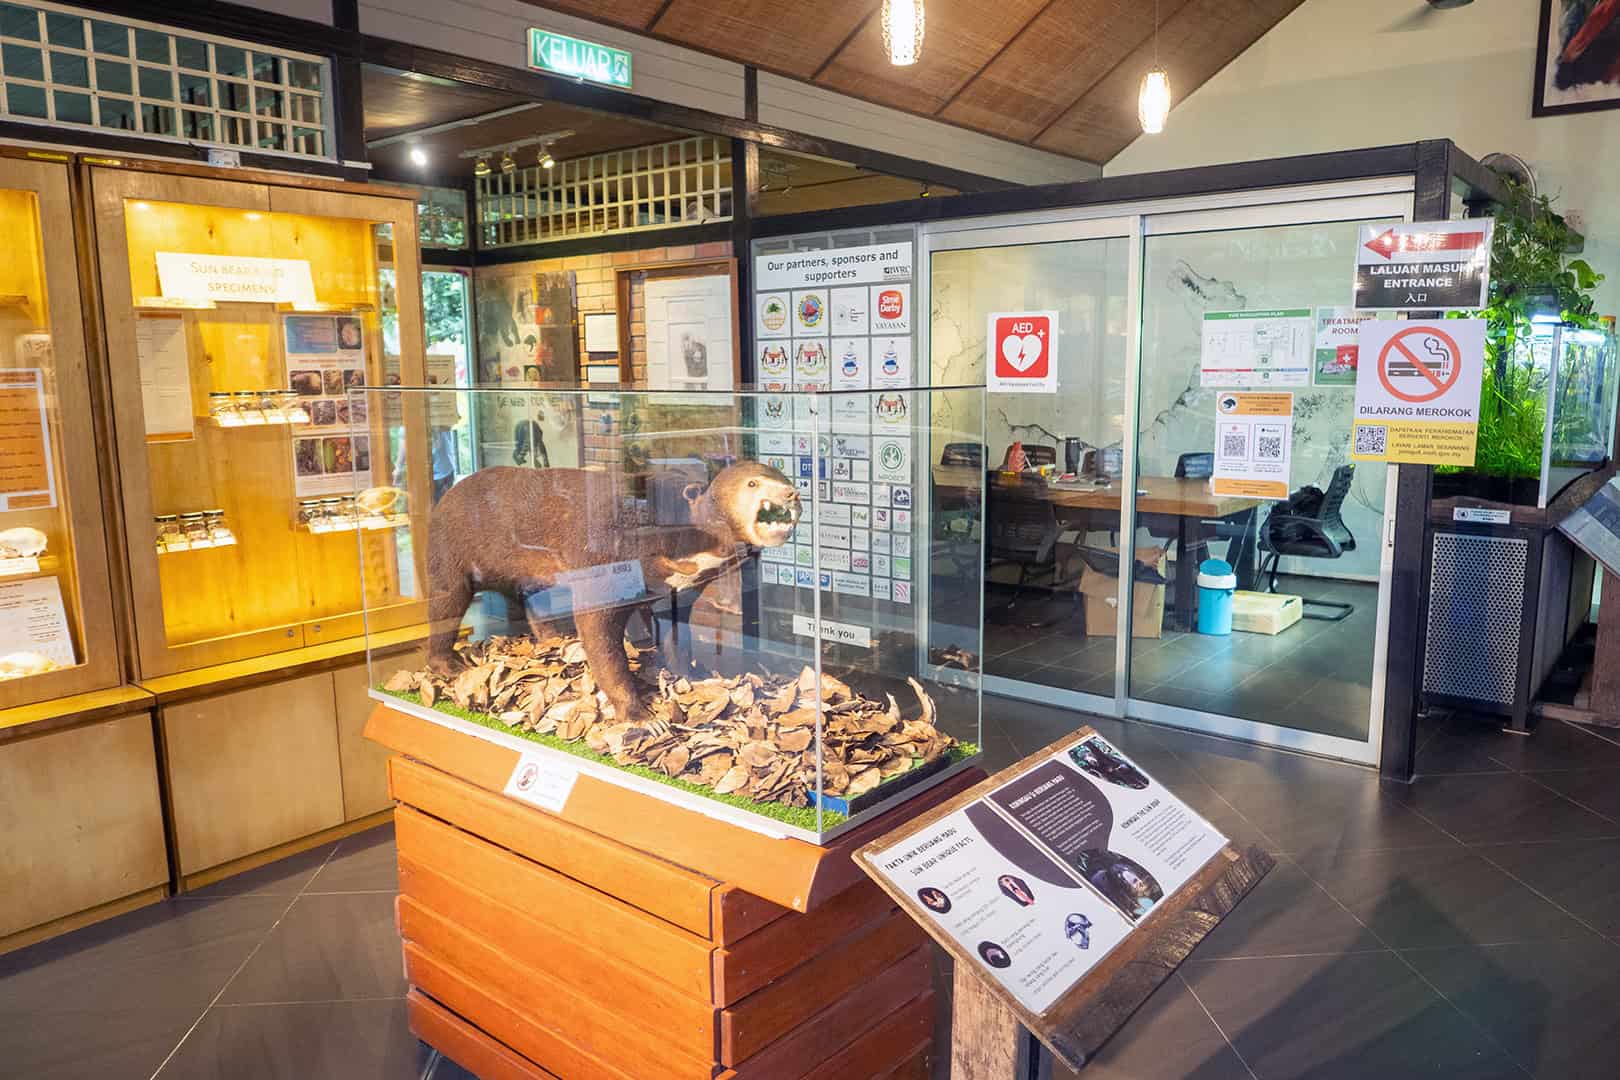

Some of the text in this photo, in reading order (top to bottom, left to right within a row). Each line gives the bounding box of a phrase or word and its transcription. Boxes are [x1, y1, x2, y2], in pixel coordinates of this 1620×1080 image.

[535, 32, 611, 77] KELUAR
[767, 249, 898, 271] Our partners, sponsors and
[1370, 264, 1419, 275] LALUAN
[804, 269, 857, 282] supporters
[1383, 278, 1453, 289] ENTRANCE
[1404, 293, 1428, 304] 入口
[880, 304, 901, 314] Darby
[1012, 322, 1033, 334] AED
[1332, 327, 1359, 335] ROOM
[1360, 406, 1472, 417] DILARANG MEROKOK
[808, 623, 855, 639] Tnk you
[957, 836, 974, 851] FACTS
